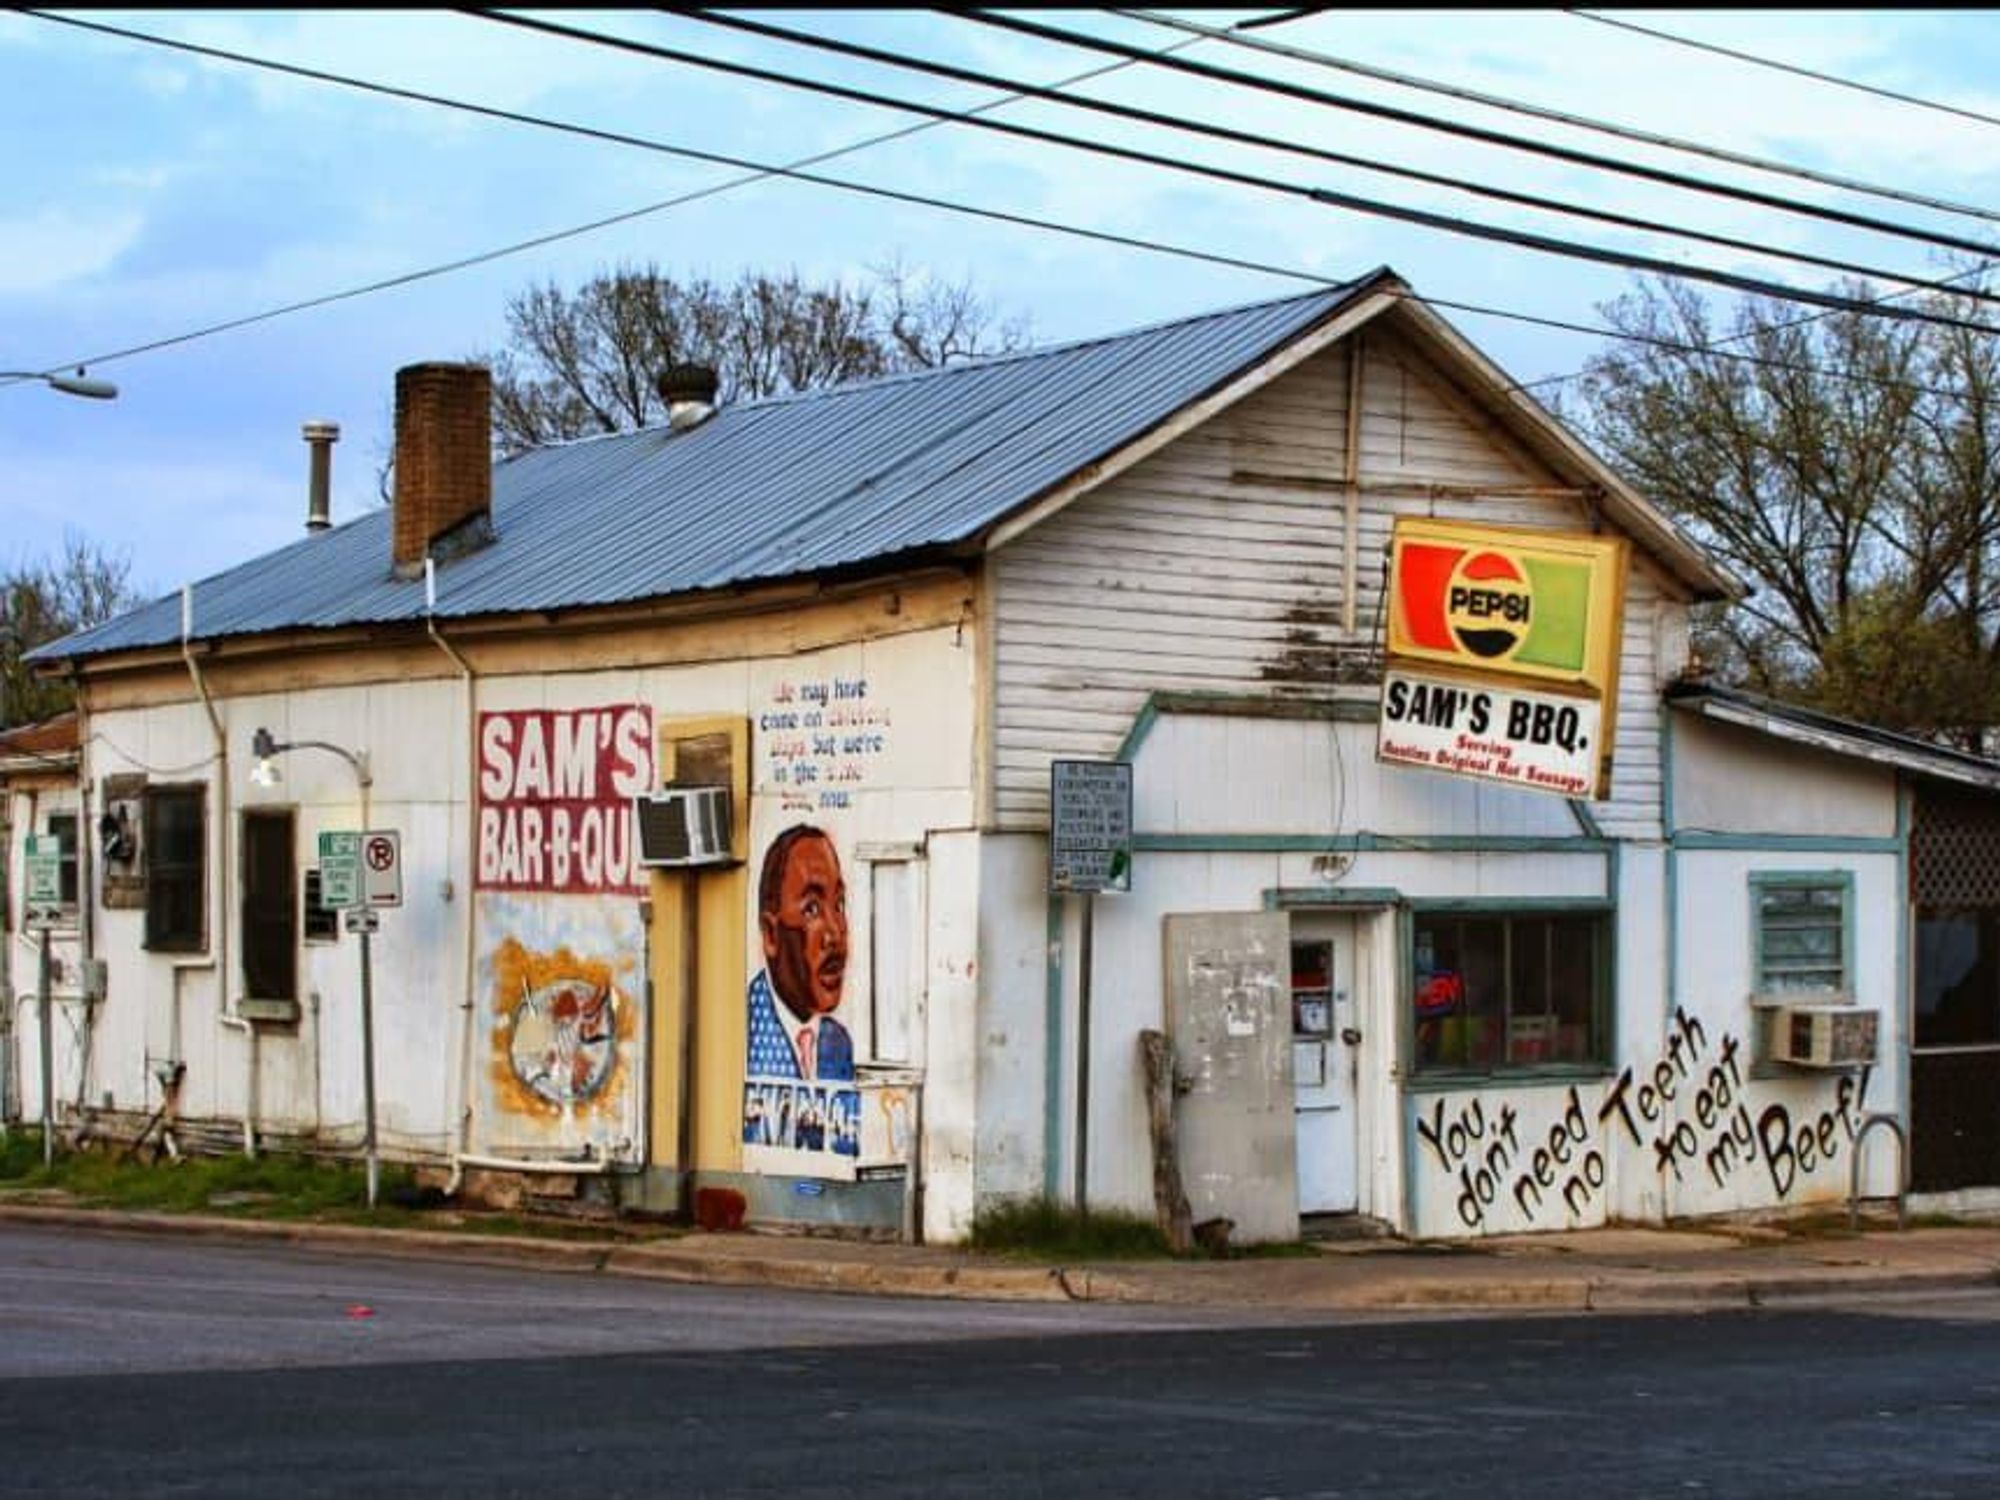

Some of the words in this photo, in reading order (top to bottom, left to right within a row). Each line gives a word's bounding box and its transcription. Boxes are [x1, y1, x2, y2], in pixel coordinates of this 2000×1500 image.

[1450, 586, 1530, 624] PEPSI
[801, 684, 829, 707] may
[1386, 681, 1491, 734] SAM'S
[1507, 700, 1588, 755] BBQ.
[480, 708, 651, 801] SAM'S
[1456, 734, 1513, 759] Serving
[1526, 765, 1585, 791] Sausage
[1600, 1005, 1707, 1147] Teeth
[1653, 1119, 1697, 1182] to
[1695, 1033, 1741, 1130] eat
[1417, 1098, 1485, 1173] You
[1513, 1085, 1588, 1221] need
[1707, 1104, 1757, 1188] my
[1757, 1063, 1873, 1199] Beef!
[1562, 1148, 1604, 1217] no
